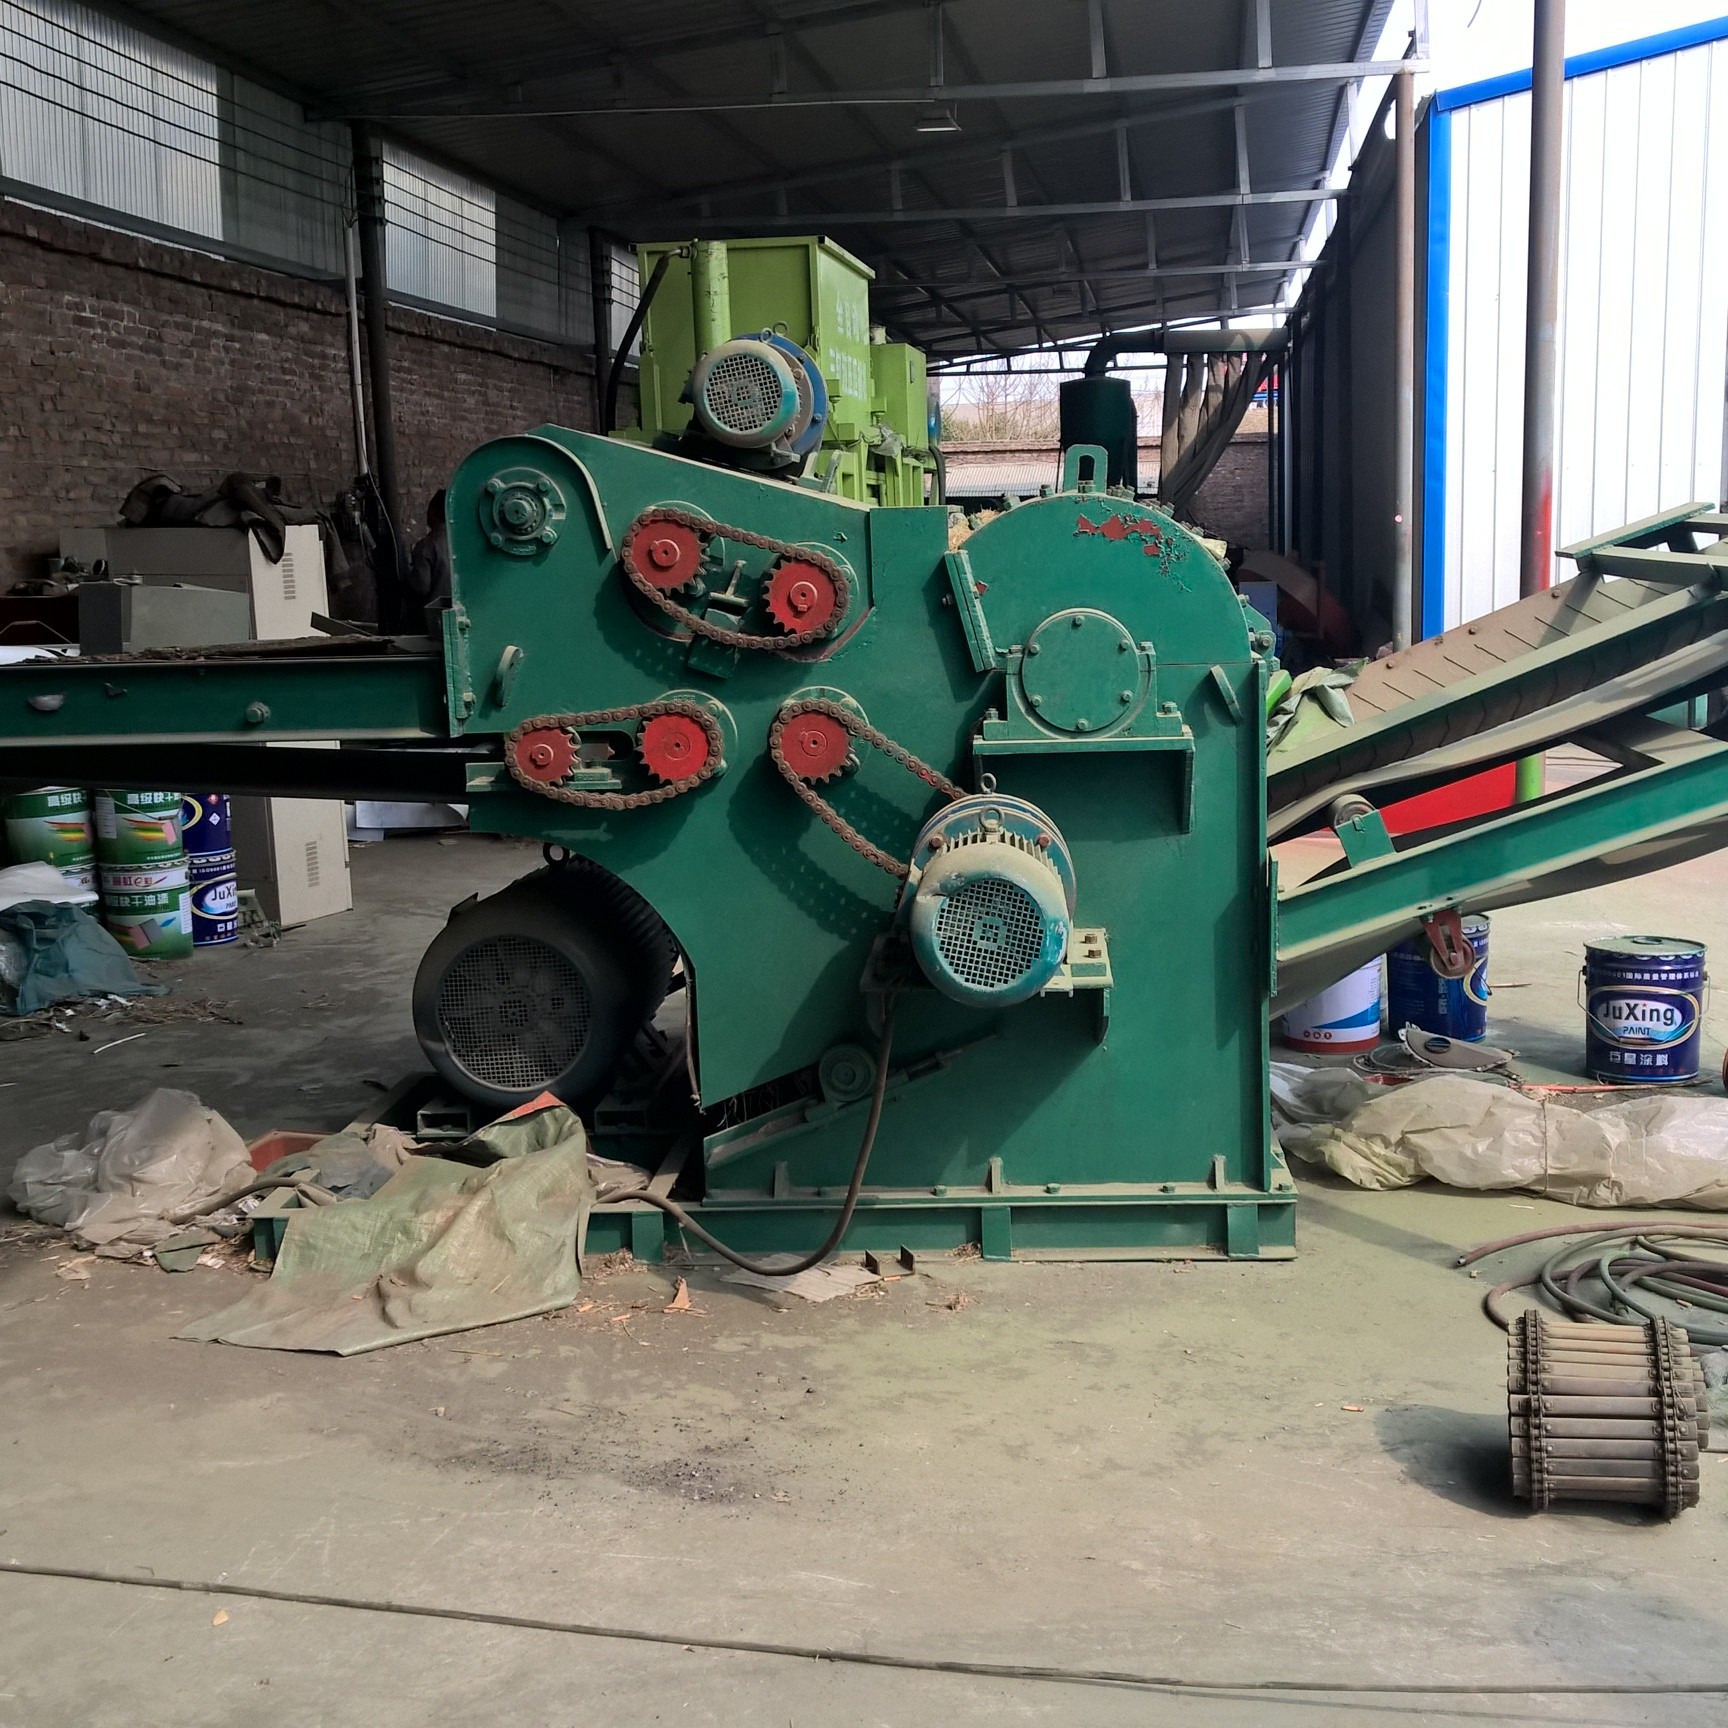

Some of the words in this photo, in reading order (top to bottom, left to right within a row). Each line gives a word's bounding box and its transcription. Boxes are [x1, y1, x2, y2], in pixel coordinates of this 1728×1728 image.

[211, 884, 237, 901] JuXi
[1603, 1002, 1676, 1027] JuXing
[1622, 1026, 1652, 1036] PAINT
[1609, 1051, 1669, 1066] 巨星涂料
